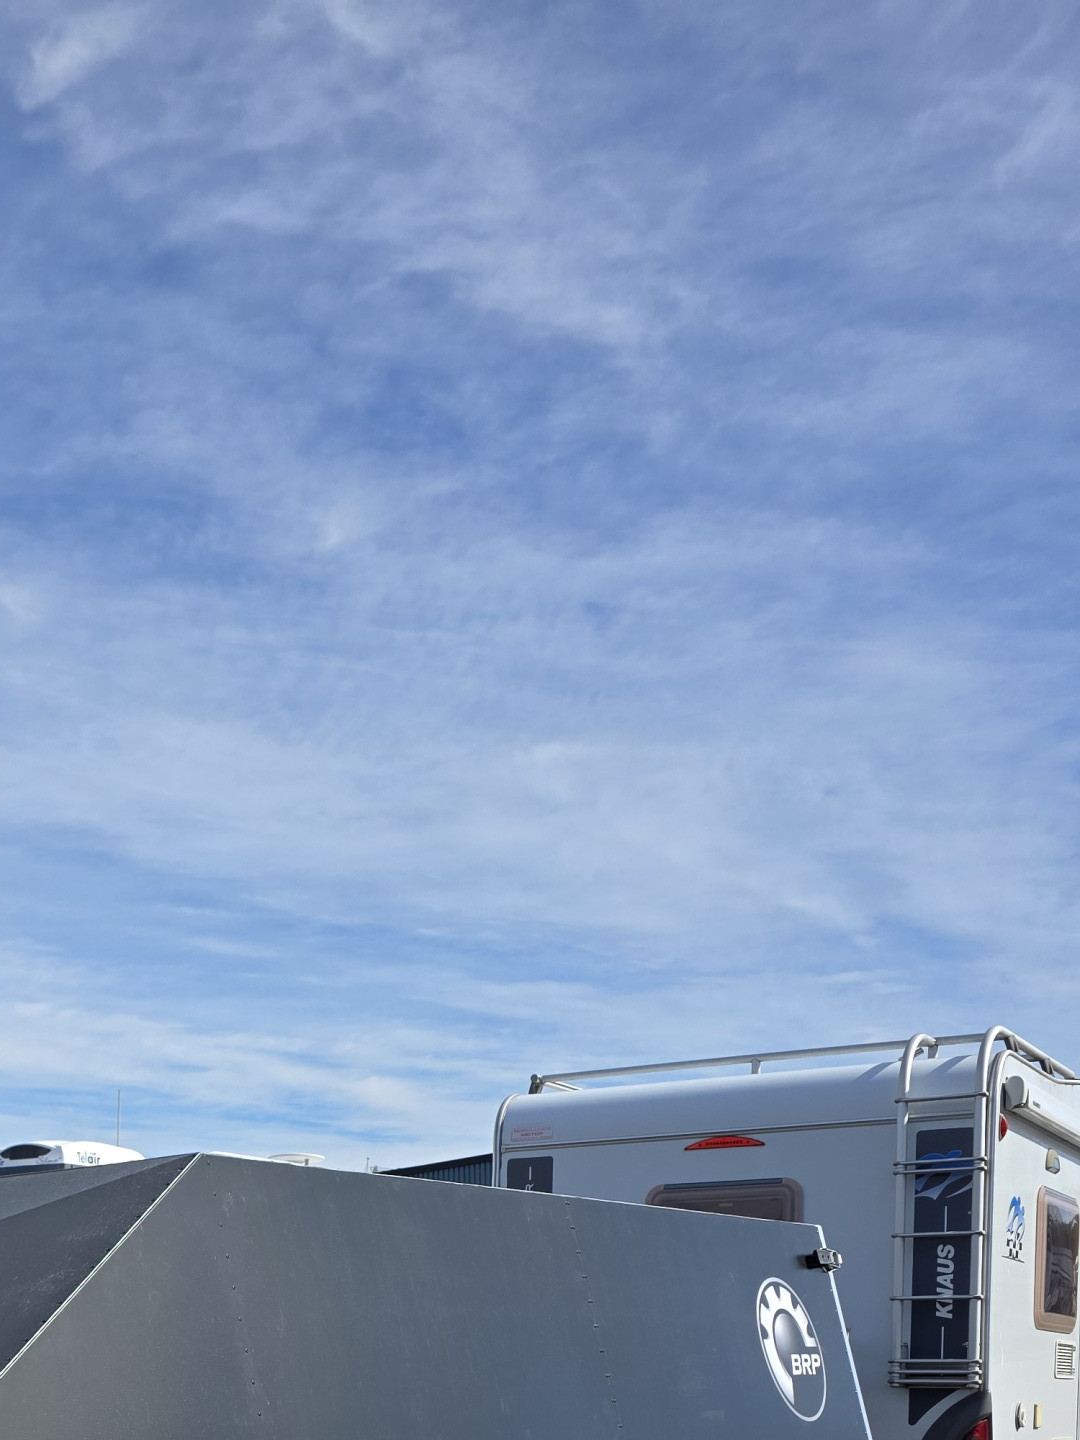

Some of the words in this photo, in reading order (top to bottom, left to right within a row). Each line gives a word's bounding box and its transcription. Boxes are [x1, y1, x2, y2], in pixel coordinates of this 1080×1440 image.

[77, 1151, 101, 1165] Telair
[935, 1244, 955, 1319] KNAUS
[790, 1353, 821, 1376] BRP
